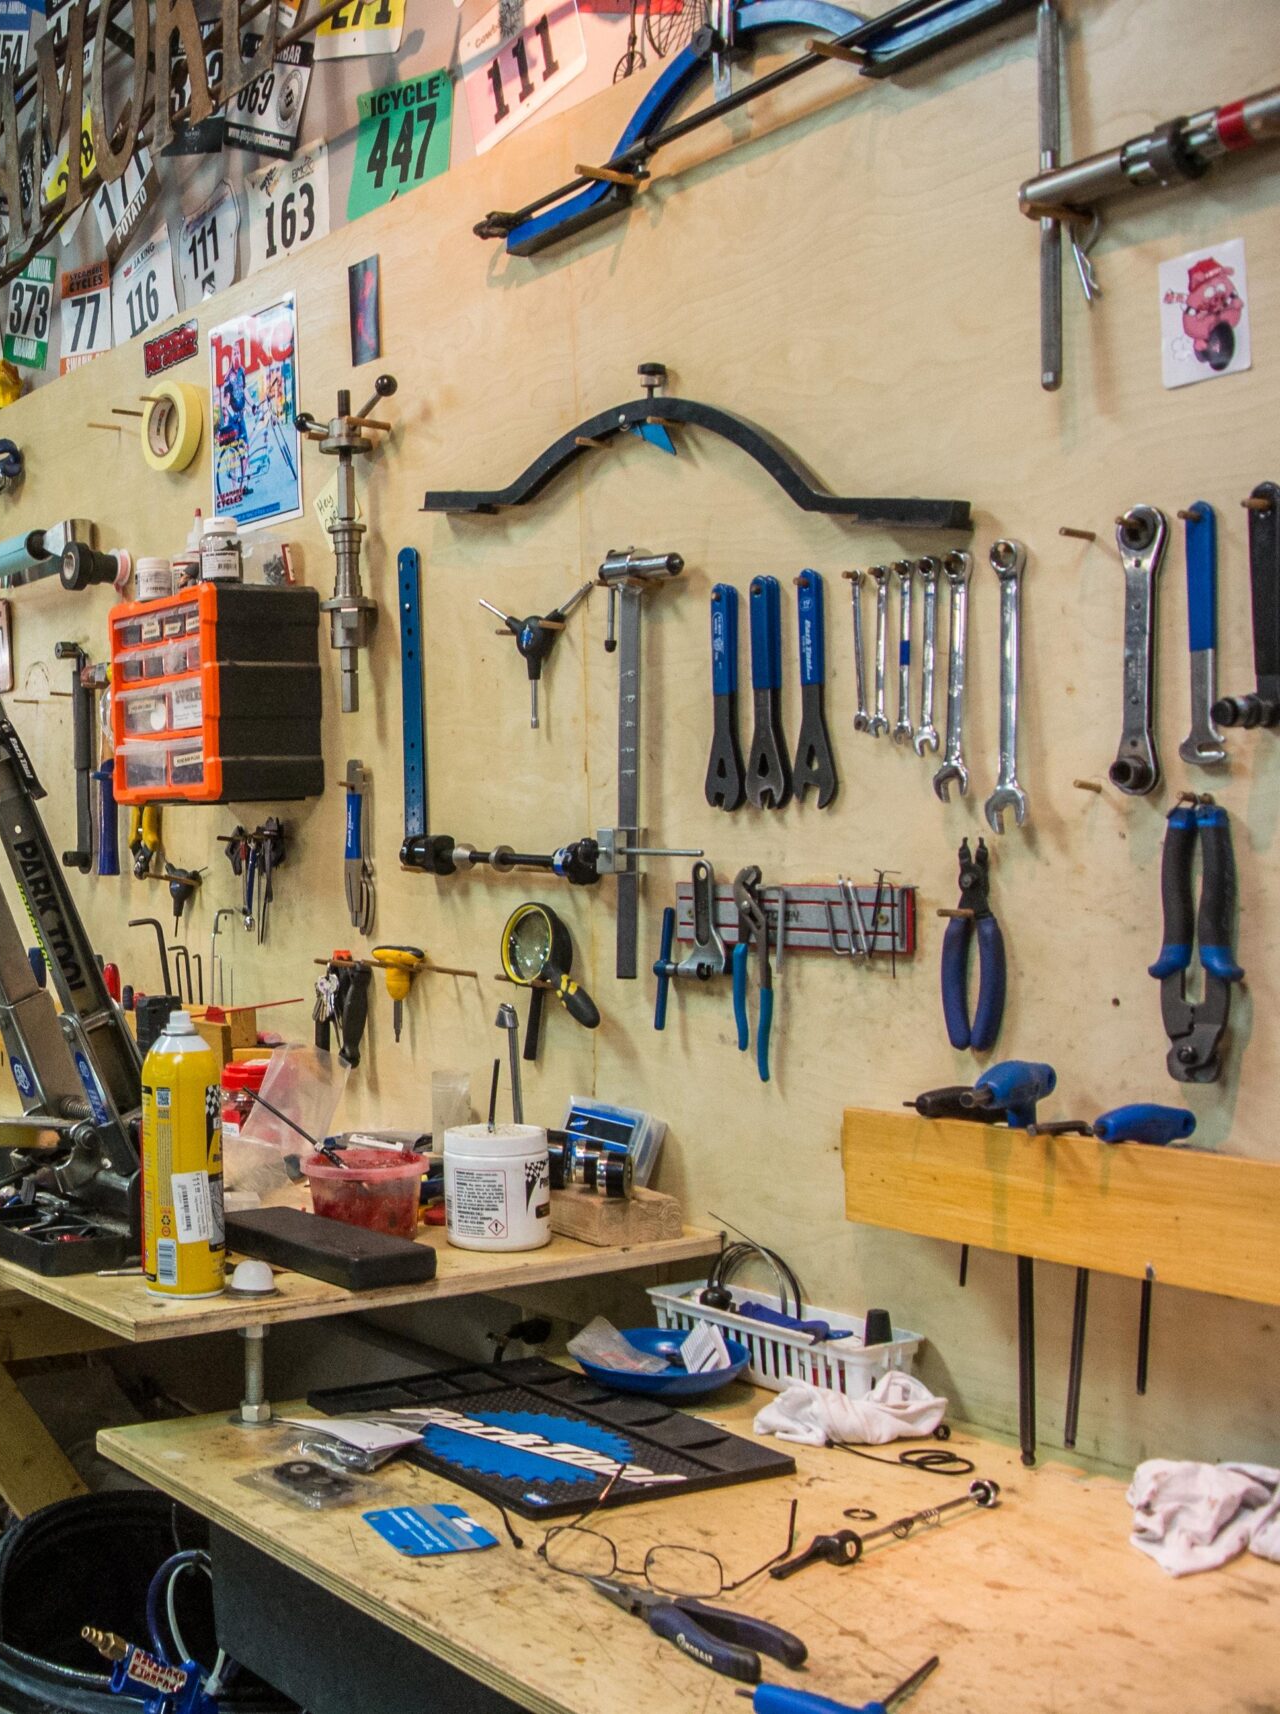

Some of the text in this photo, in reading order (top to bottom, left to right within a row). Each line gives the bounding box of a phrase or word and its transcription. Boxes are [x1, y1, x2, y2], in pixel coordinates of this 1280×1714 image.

[370, 76, 420, 116] ICYCLE
[487, 14, 559, 125] 111
[367, 102, 437, 188] 447
[115, 187, 147, 242] POTATO
[265, 182, 314, 259] 163
[70, 265, 102, 282] SYCAMORE
[188, 216, 219, 280] 111
[9, 282, 50, 339] 373
[70, 273, 103, 293] CYCLES
[126, 270, 160, 338] 116
[70, 294, 101, 353] 77
[210, 314, 294, 388] bike
[216, 496, 244, 509] CYCLES
[13, 842, 87, 991] PARK TOOL
